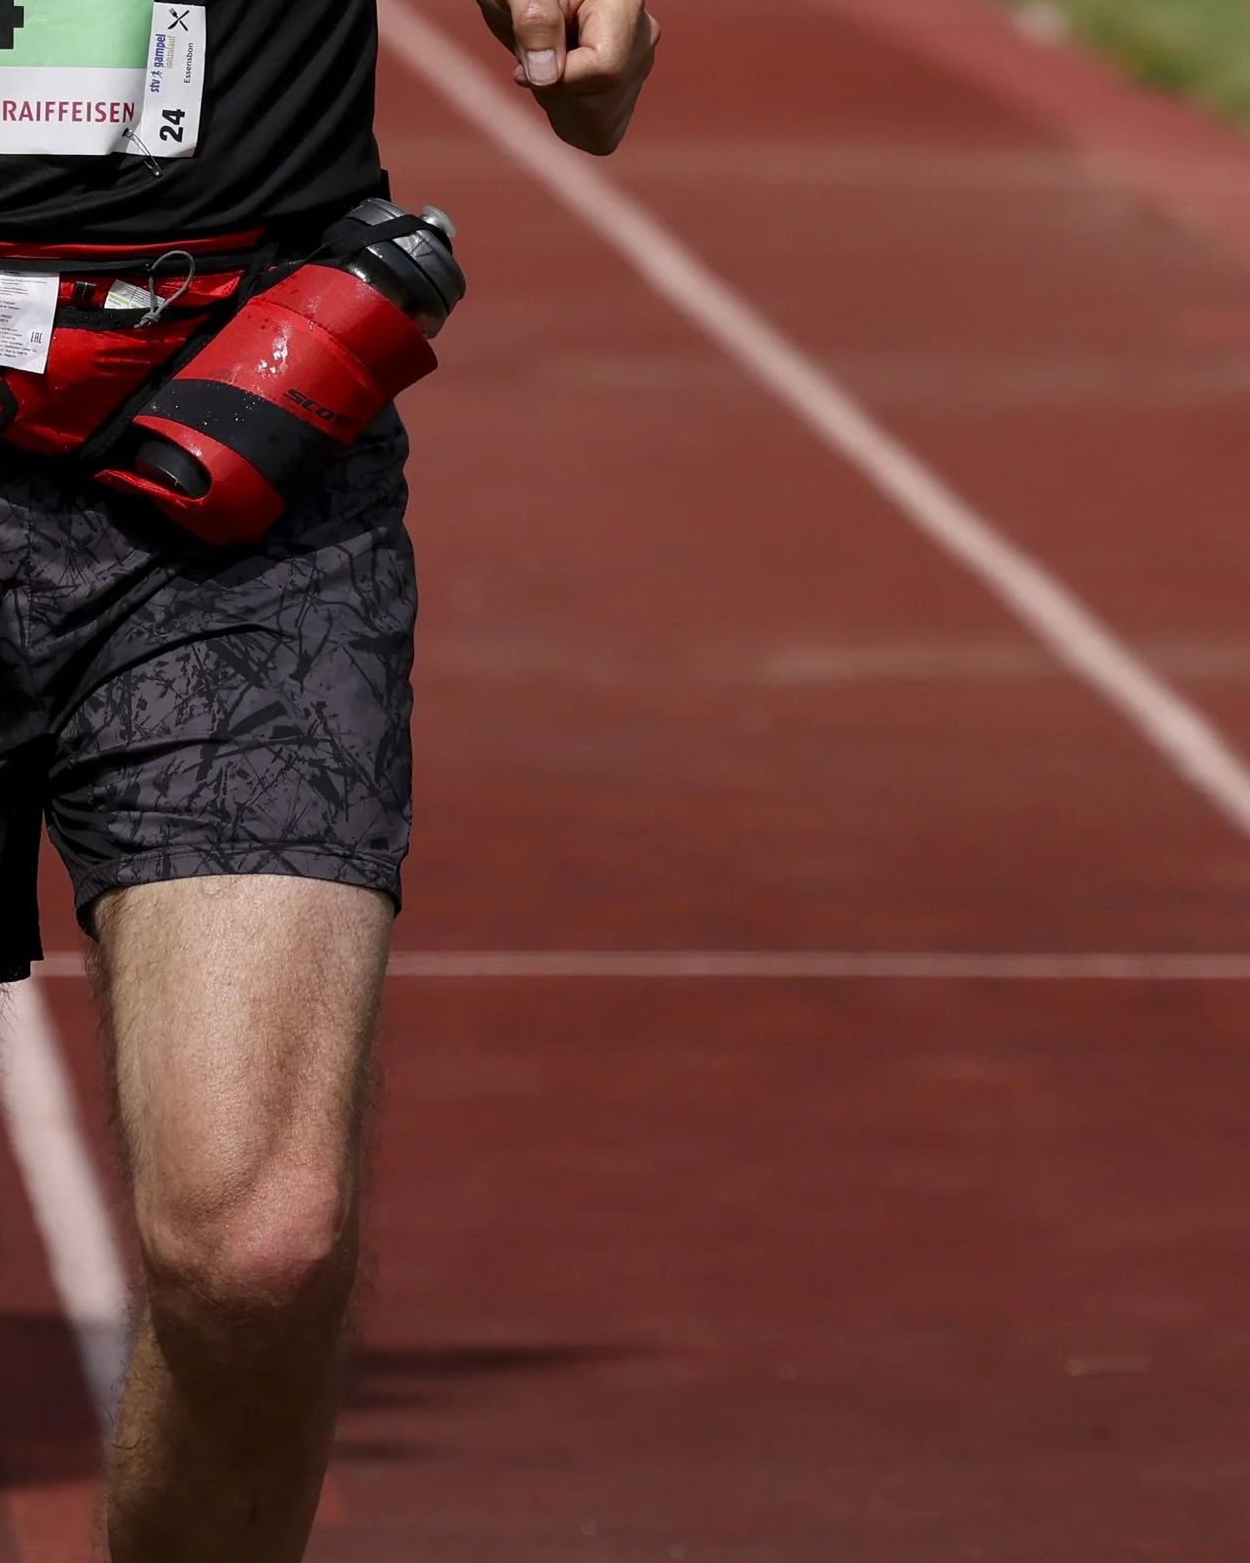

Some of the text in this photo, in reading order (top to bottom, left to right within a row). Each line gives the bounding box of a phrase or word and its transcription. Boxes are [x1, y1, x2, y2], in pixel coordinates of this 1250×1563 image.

[150, 33, 167, 93] stv gampel
[183, 42, 194, 84] Essensbon
[1, 100, 135, 124] RAIFFEISEN
[159, 108, 186, 143] 24
